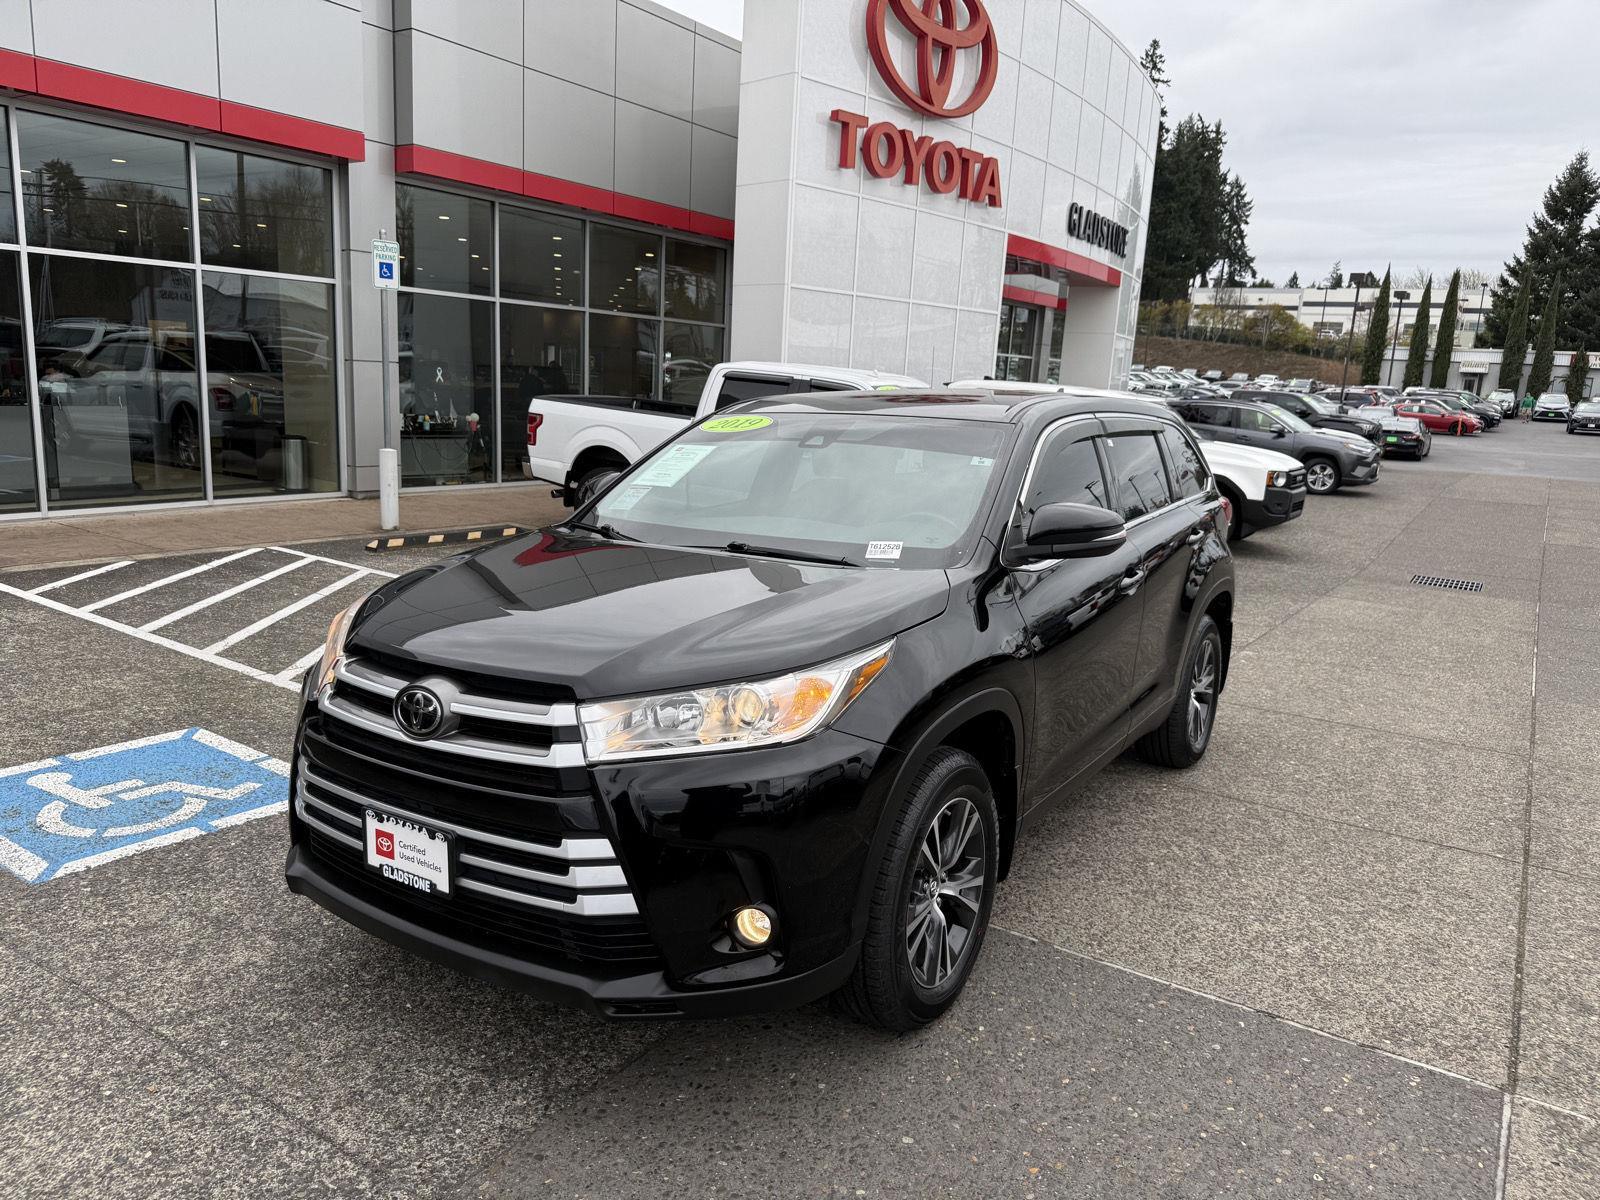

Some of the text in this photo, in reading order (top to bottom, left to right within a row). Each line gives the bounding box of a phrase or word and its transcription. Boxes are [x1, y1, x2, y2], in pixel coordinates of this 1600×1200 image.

[830, 108, 1002, 208] TOYOTA
[1067, 202, 1129, 259] GLADSTONE
[374, 245, 397, 254] RESERVED
[376, 253, 396, 261] PARKING
[710, 417, 764, 430] 2019
[382, 814, 428, 836] TOYOTA
[398, 840, 426, 856] Certified
[398, 852, 442, 873] Used Vehicles
[383, 865, 431, 892] GLADSTONE
